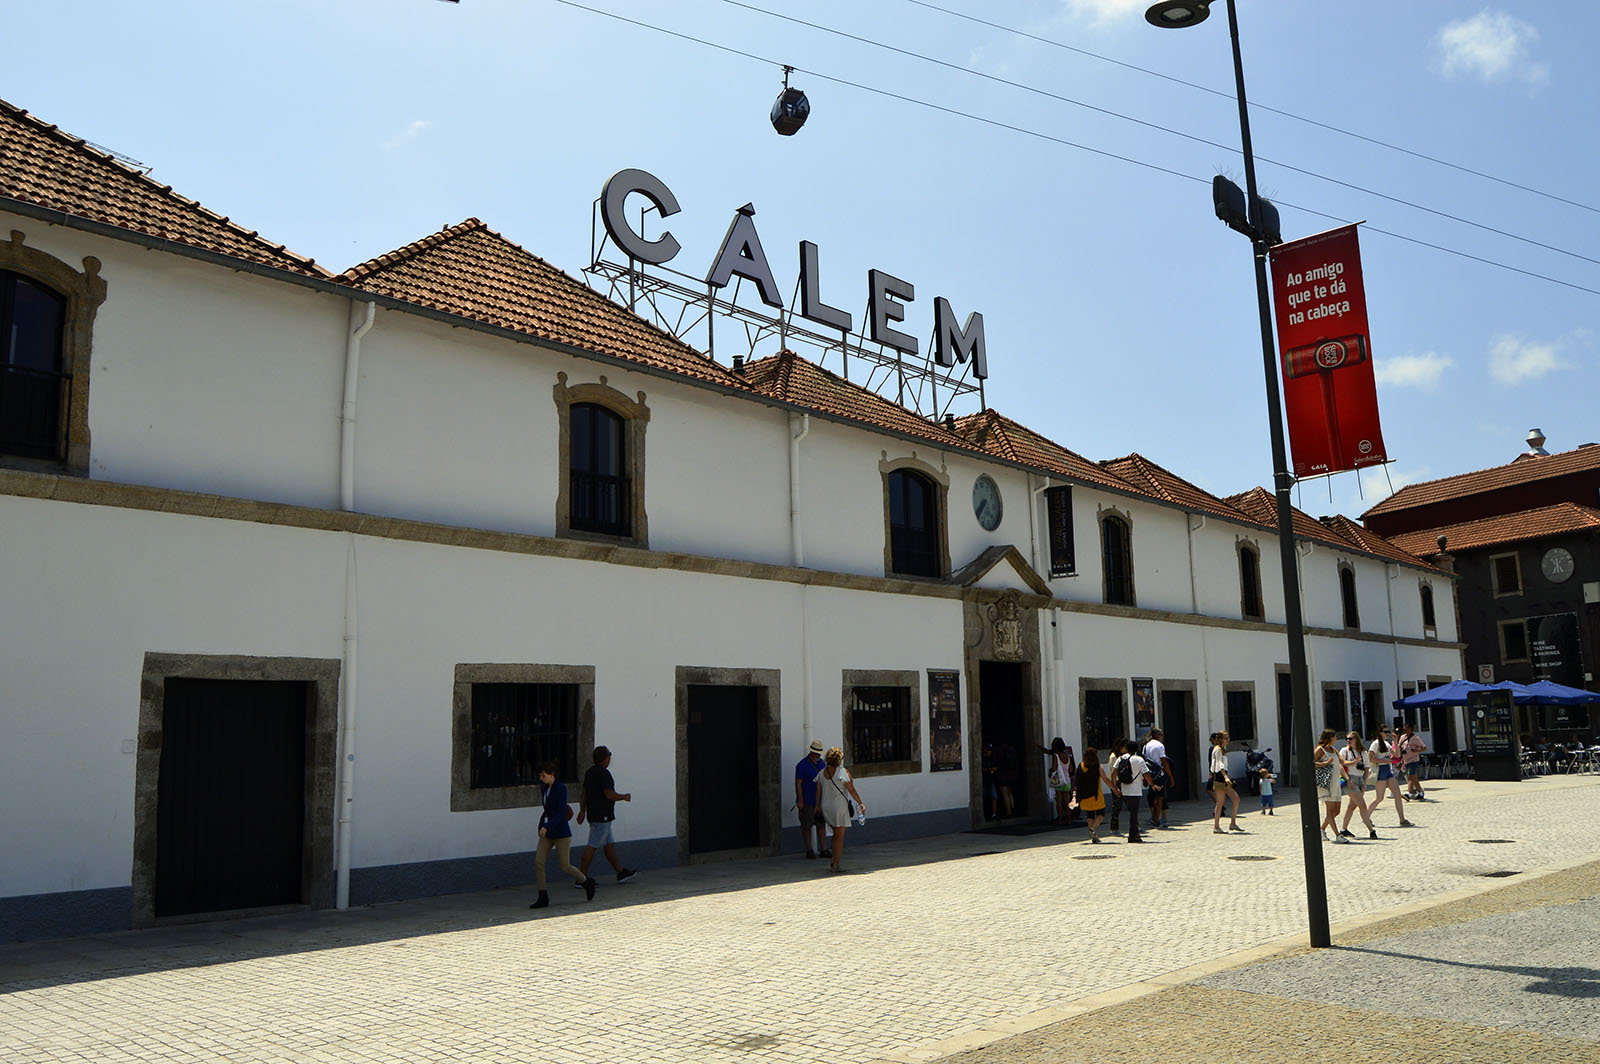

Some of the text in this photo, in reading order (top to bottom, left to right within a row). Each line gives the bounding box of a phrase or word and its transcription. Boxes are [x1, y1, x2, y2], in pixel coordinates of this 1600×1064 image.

[1287, 262, 1344, 287] Ao amigo
[1288, 279, 1347, 309] que te dá
[1289, 300, 1351, 325] na cabeça
[1311, 463, 1328, 471] GAIA
